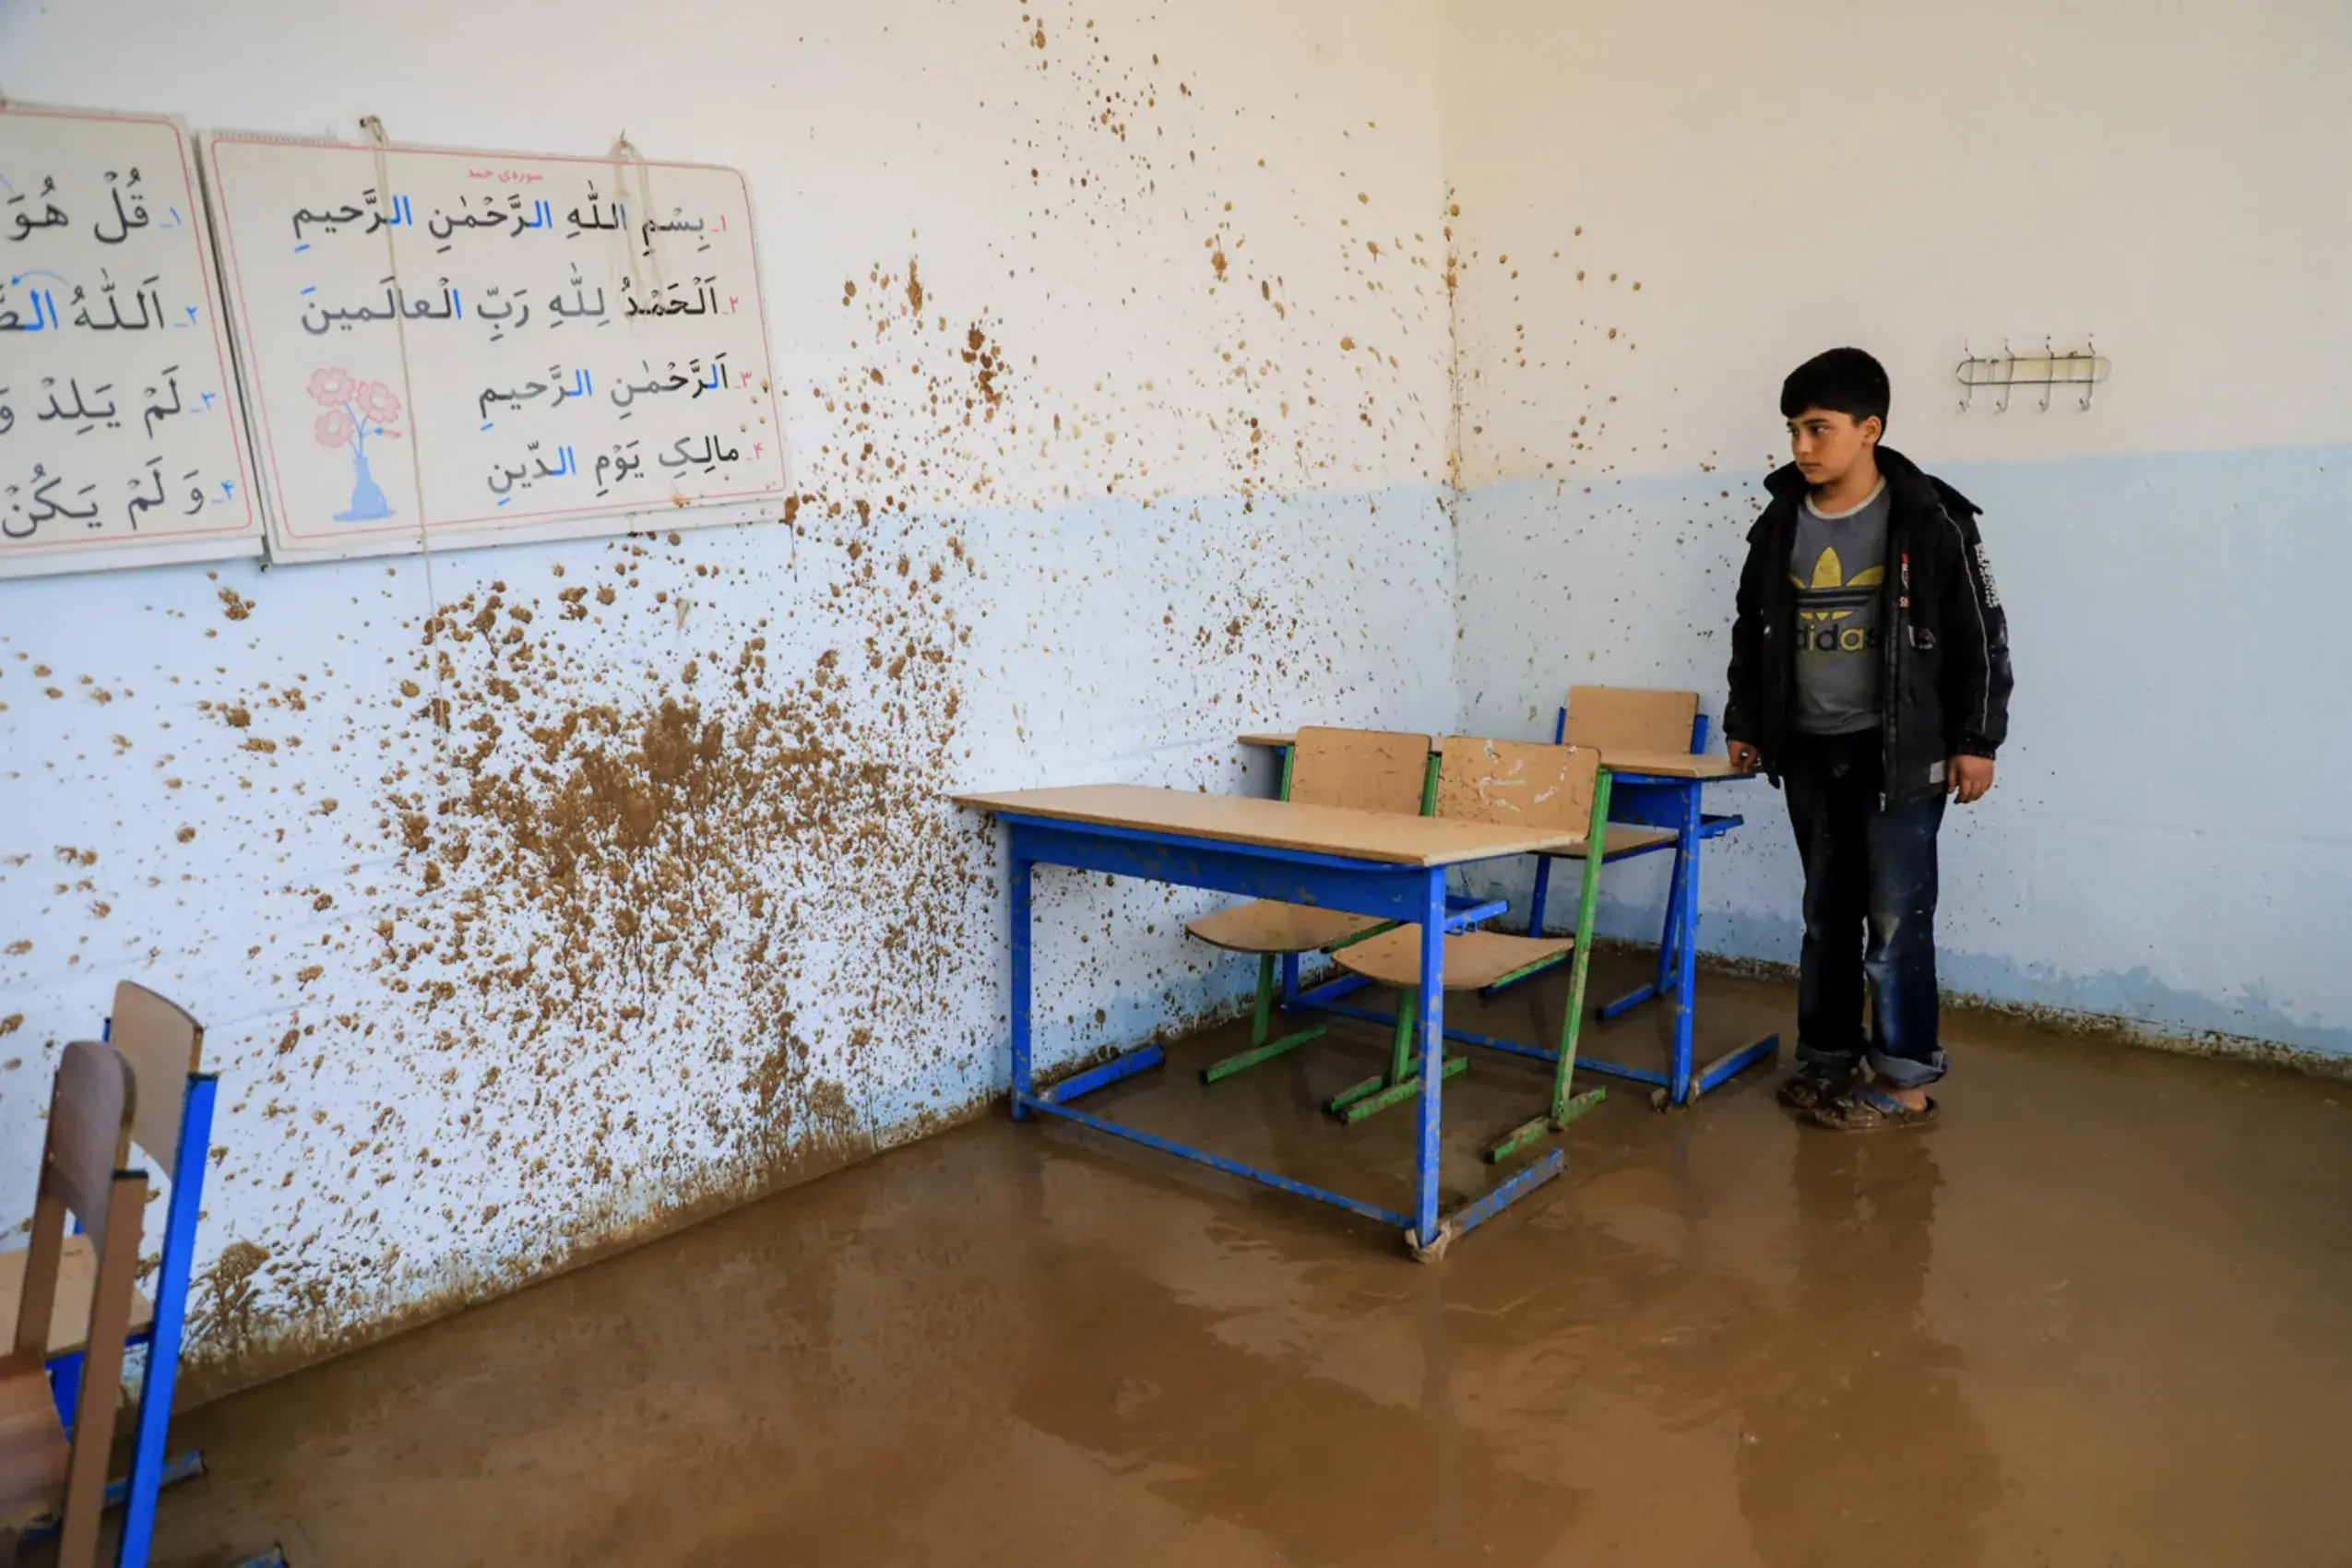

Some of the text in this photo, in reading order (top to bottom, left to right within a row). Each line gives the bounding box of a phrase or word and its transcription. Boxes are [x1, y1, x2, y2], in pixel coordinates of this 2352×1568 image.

[6, 174, 69, 242] هُوَ
[94, 167, 149, 244] قُلْ
[642, 208, 710, 256] بِسْمِ
[144, 364, 181, 440] لَمْ
[127, 456, 165, 531] لَمْ
[182, 469, 205, 515] وَ
